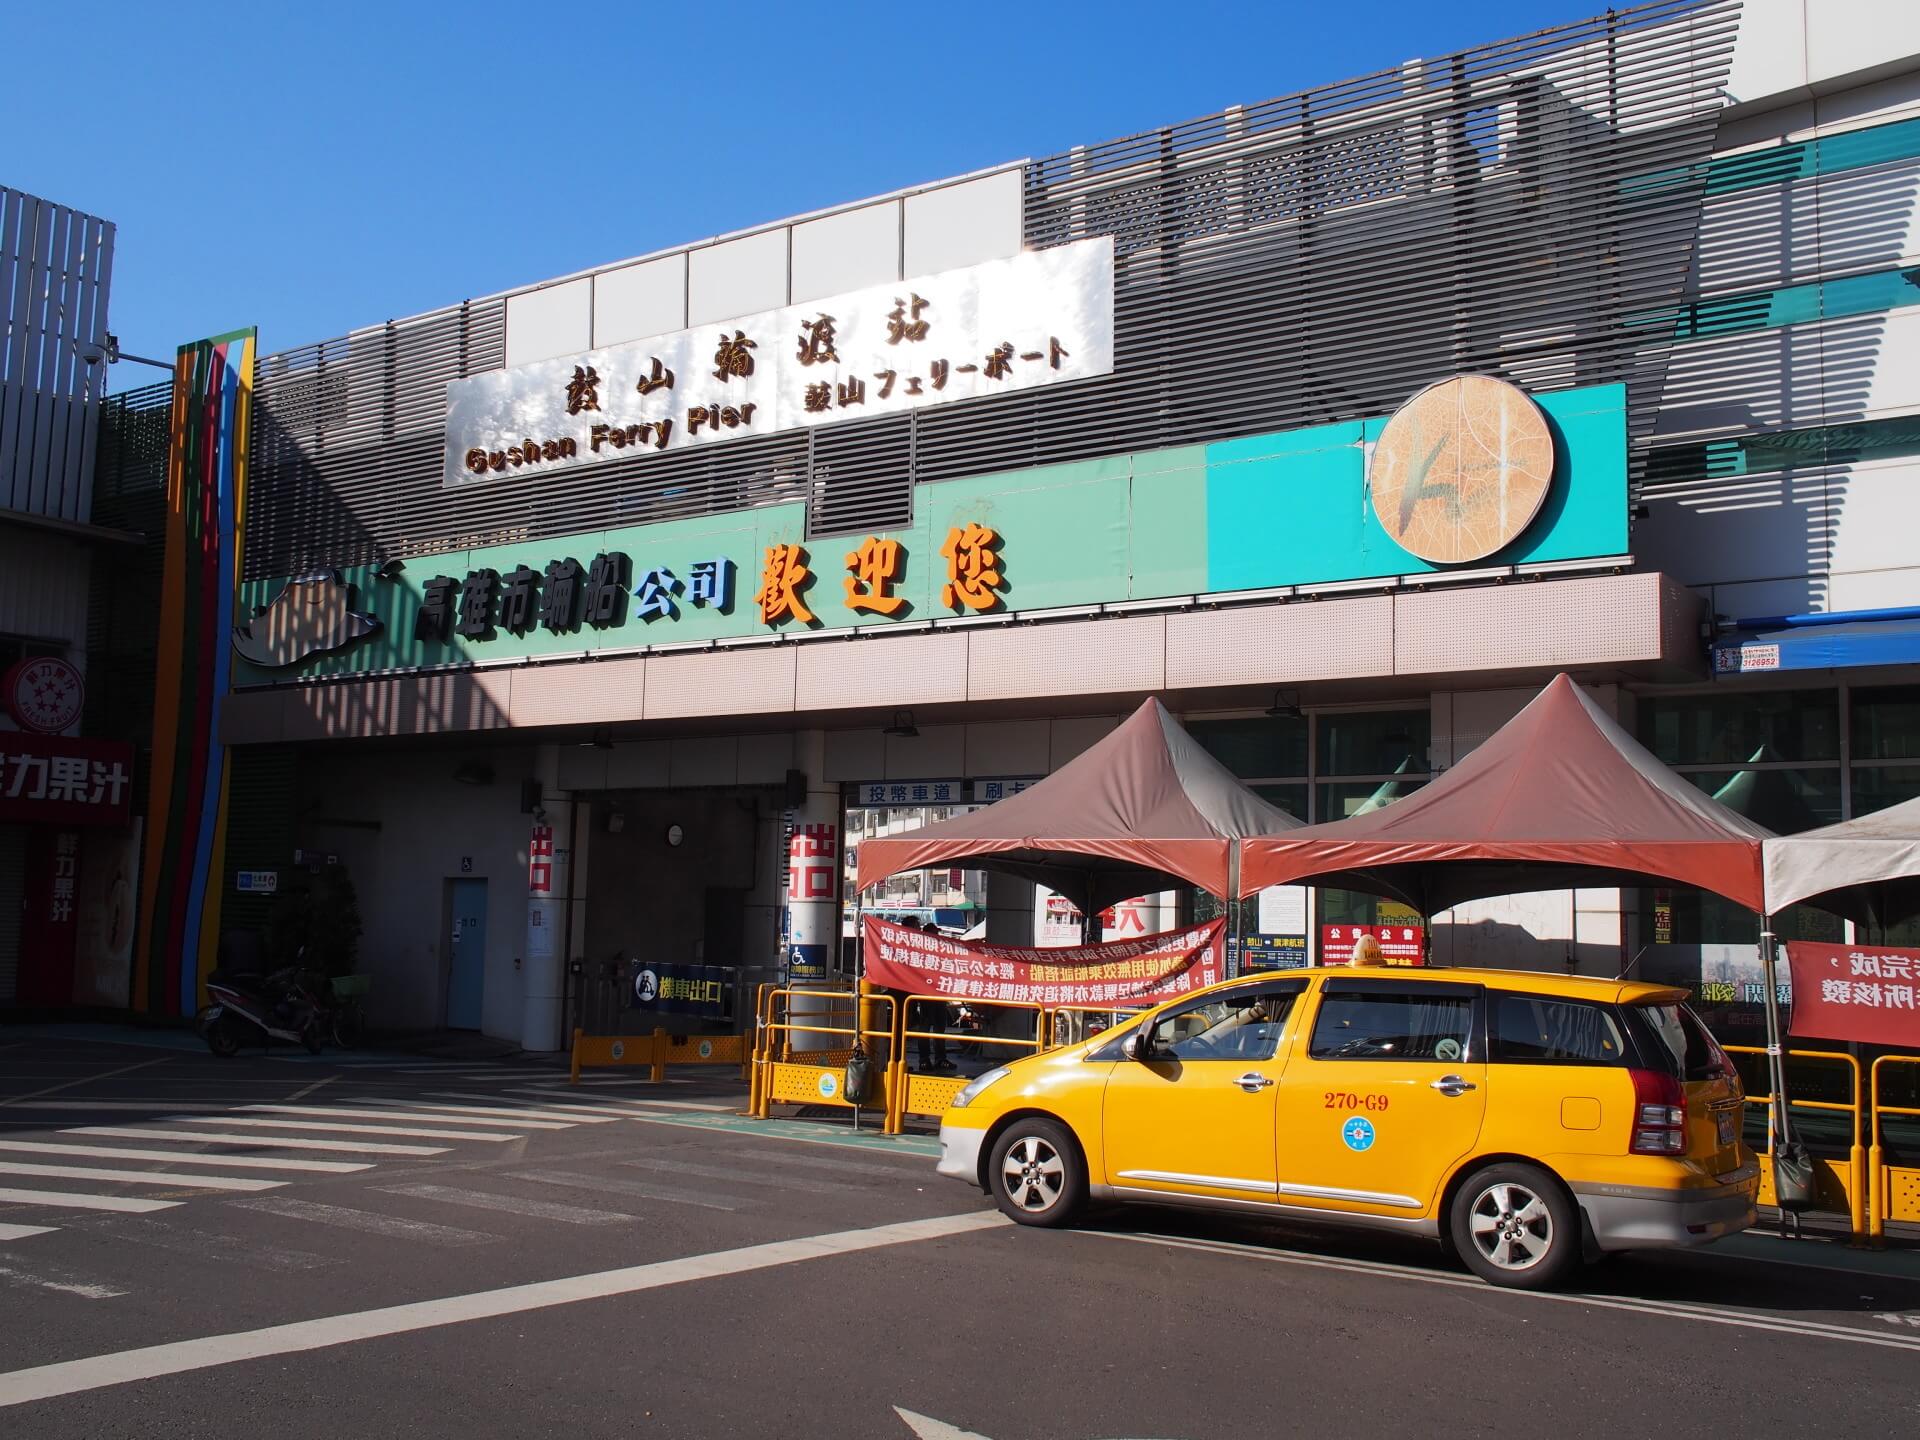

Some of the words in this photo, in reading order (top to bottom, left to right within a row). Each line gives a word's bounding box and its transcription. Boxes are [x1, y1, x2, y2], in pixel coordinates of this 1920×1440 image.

[465, 435, 577, 475] Gushan
[590, 417, 672, 451] Ferry
[688, 400, 757, 435] Pier
[419, 553, 733, 642] 高雄市輪船公司
[754, 523, 1000, 625] 歡迎您
[0, 753, 129, 805] 力果汁
[867, 783, 951, 802] 投幣車道
[985, 782, 1036, 799] 刷卡
[804, 823, 835, 898] 出口
[659, 976, 721, 1003] 機車出口
[1324, 1092, 1389, 1111] 270-G9
